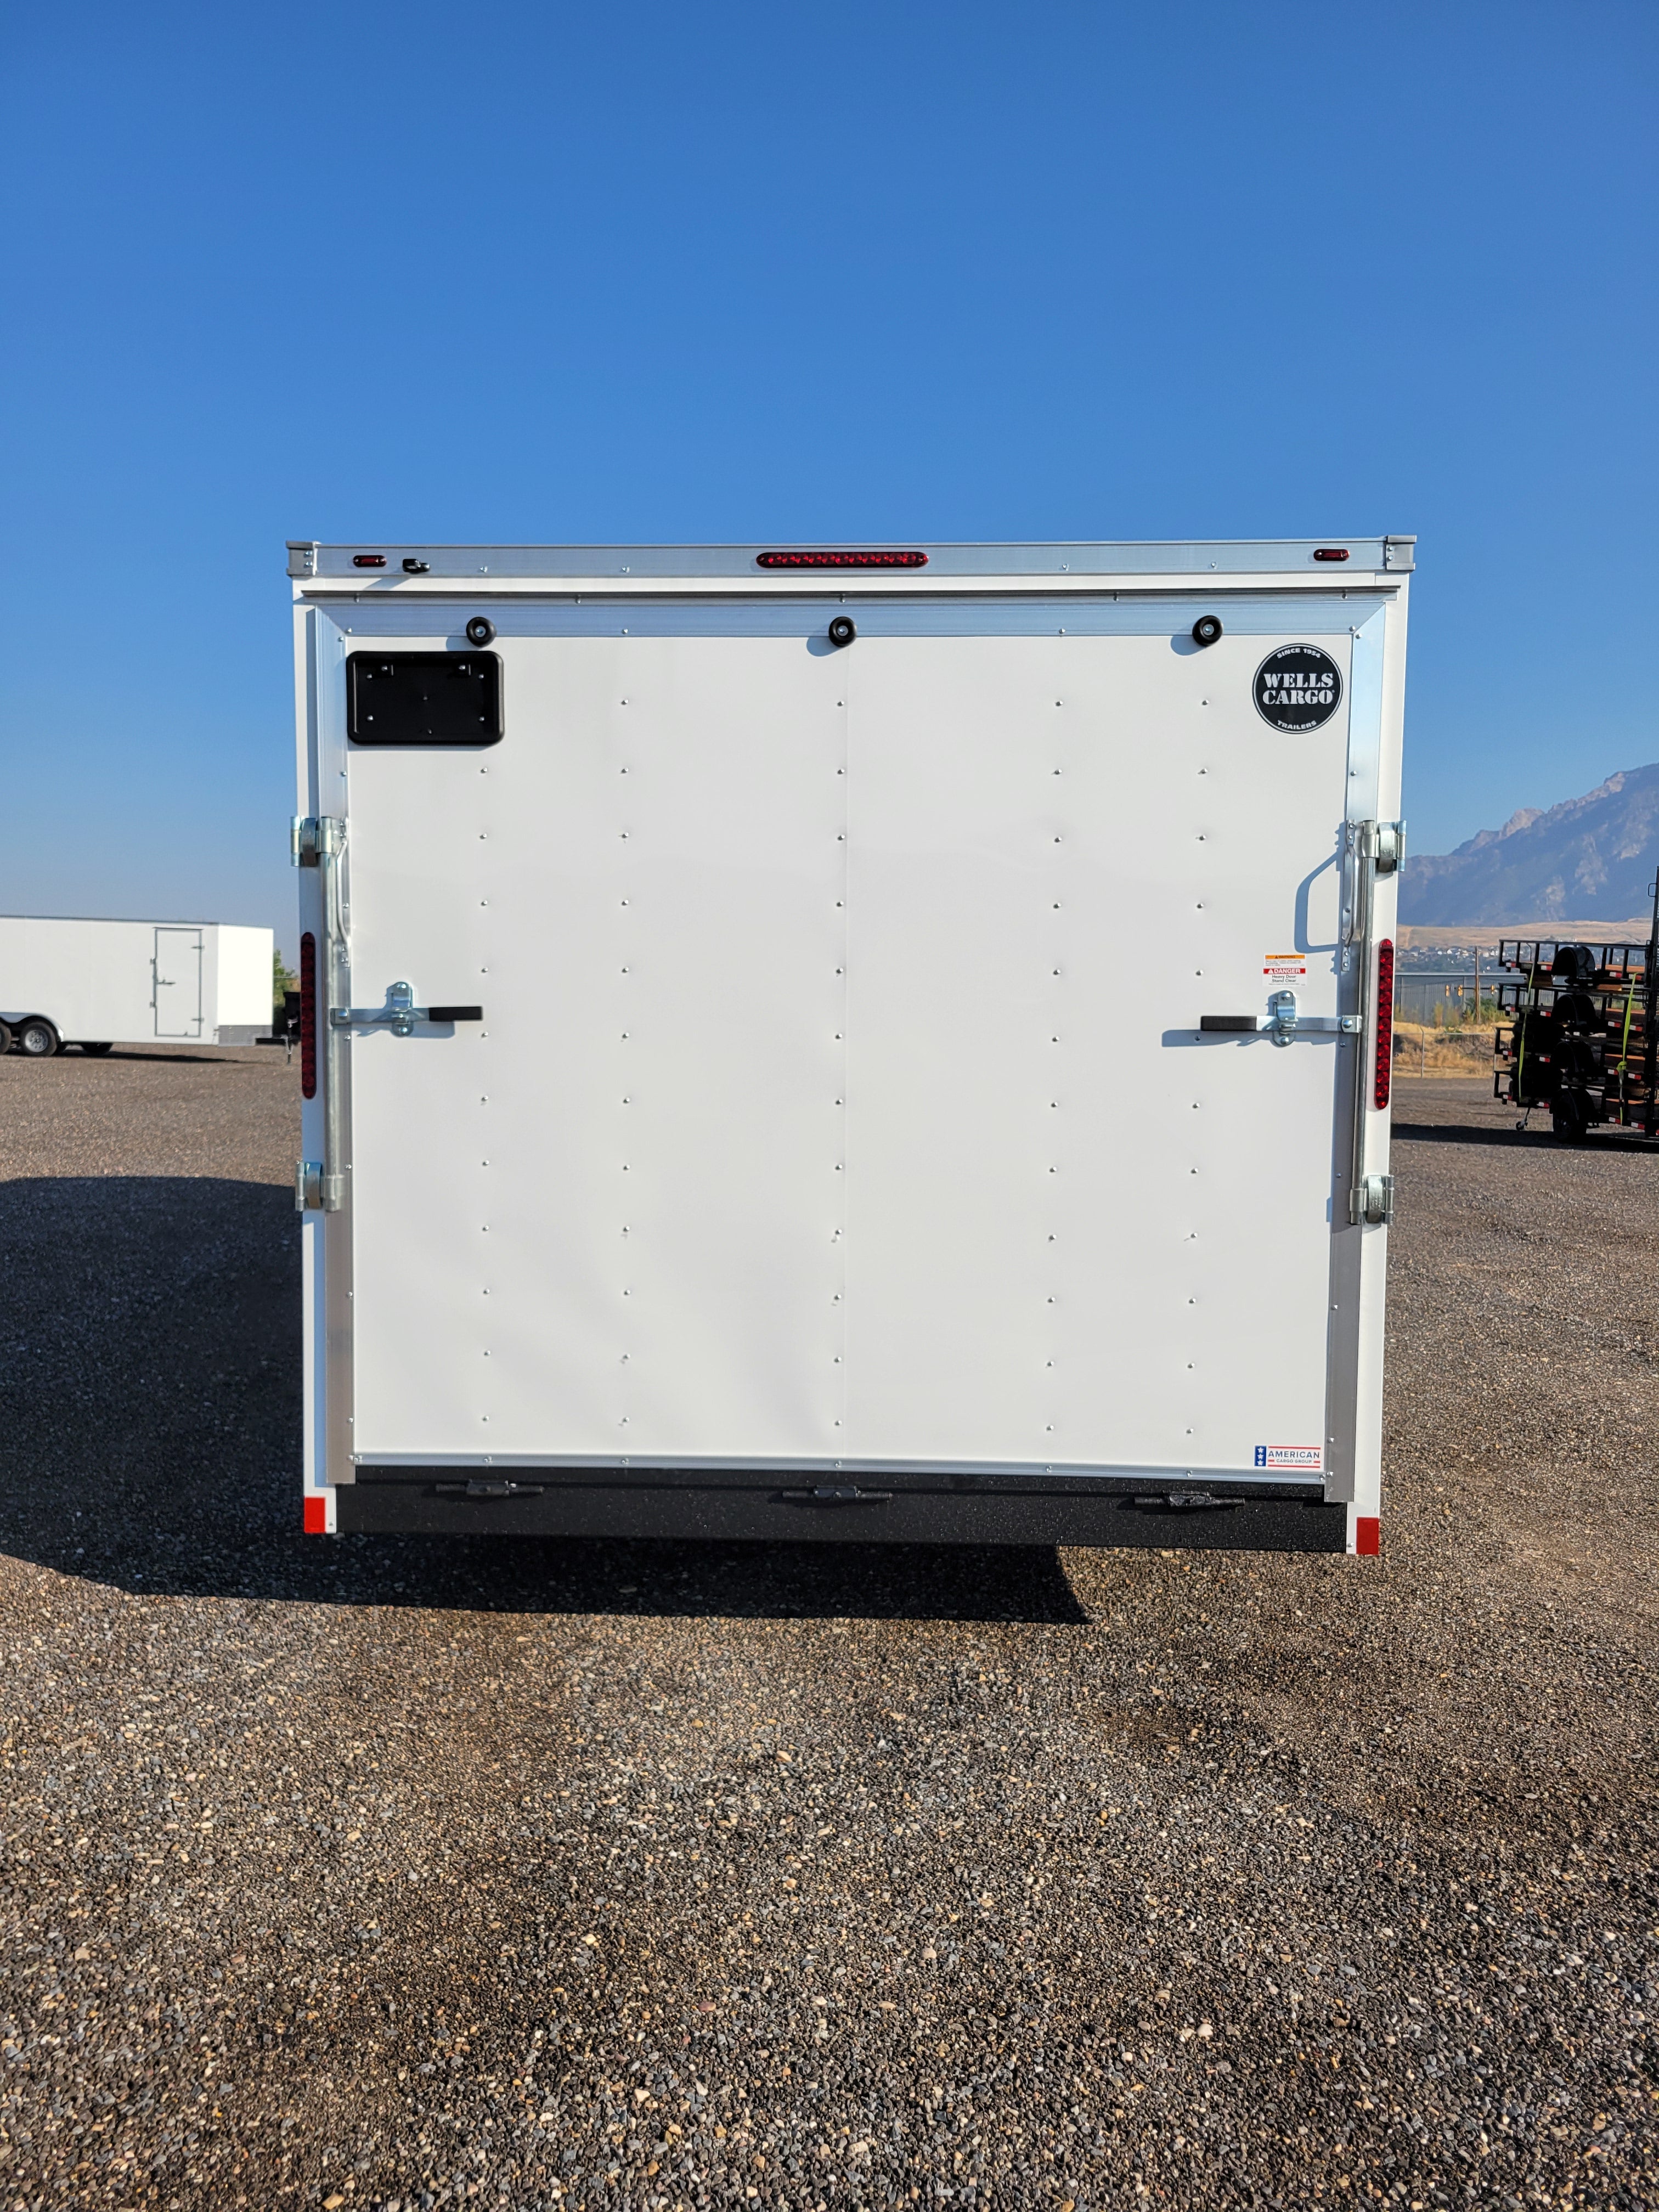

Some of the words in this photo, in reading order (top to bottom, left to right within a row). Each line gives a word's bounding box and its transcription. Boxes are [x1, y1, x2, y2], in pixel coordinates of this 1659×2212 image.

[1277, 647, 1301, 659] SINCE
[1303, 648, 1321, 658] 1954
[1263, 673, 1334, 688] WELLS
[1262, 690, 1333, 705] CARGO
[1277, 719, 1317, 730] TRAILERS
